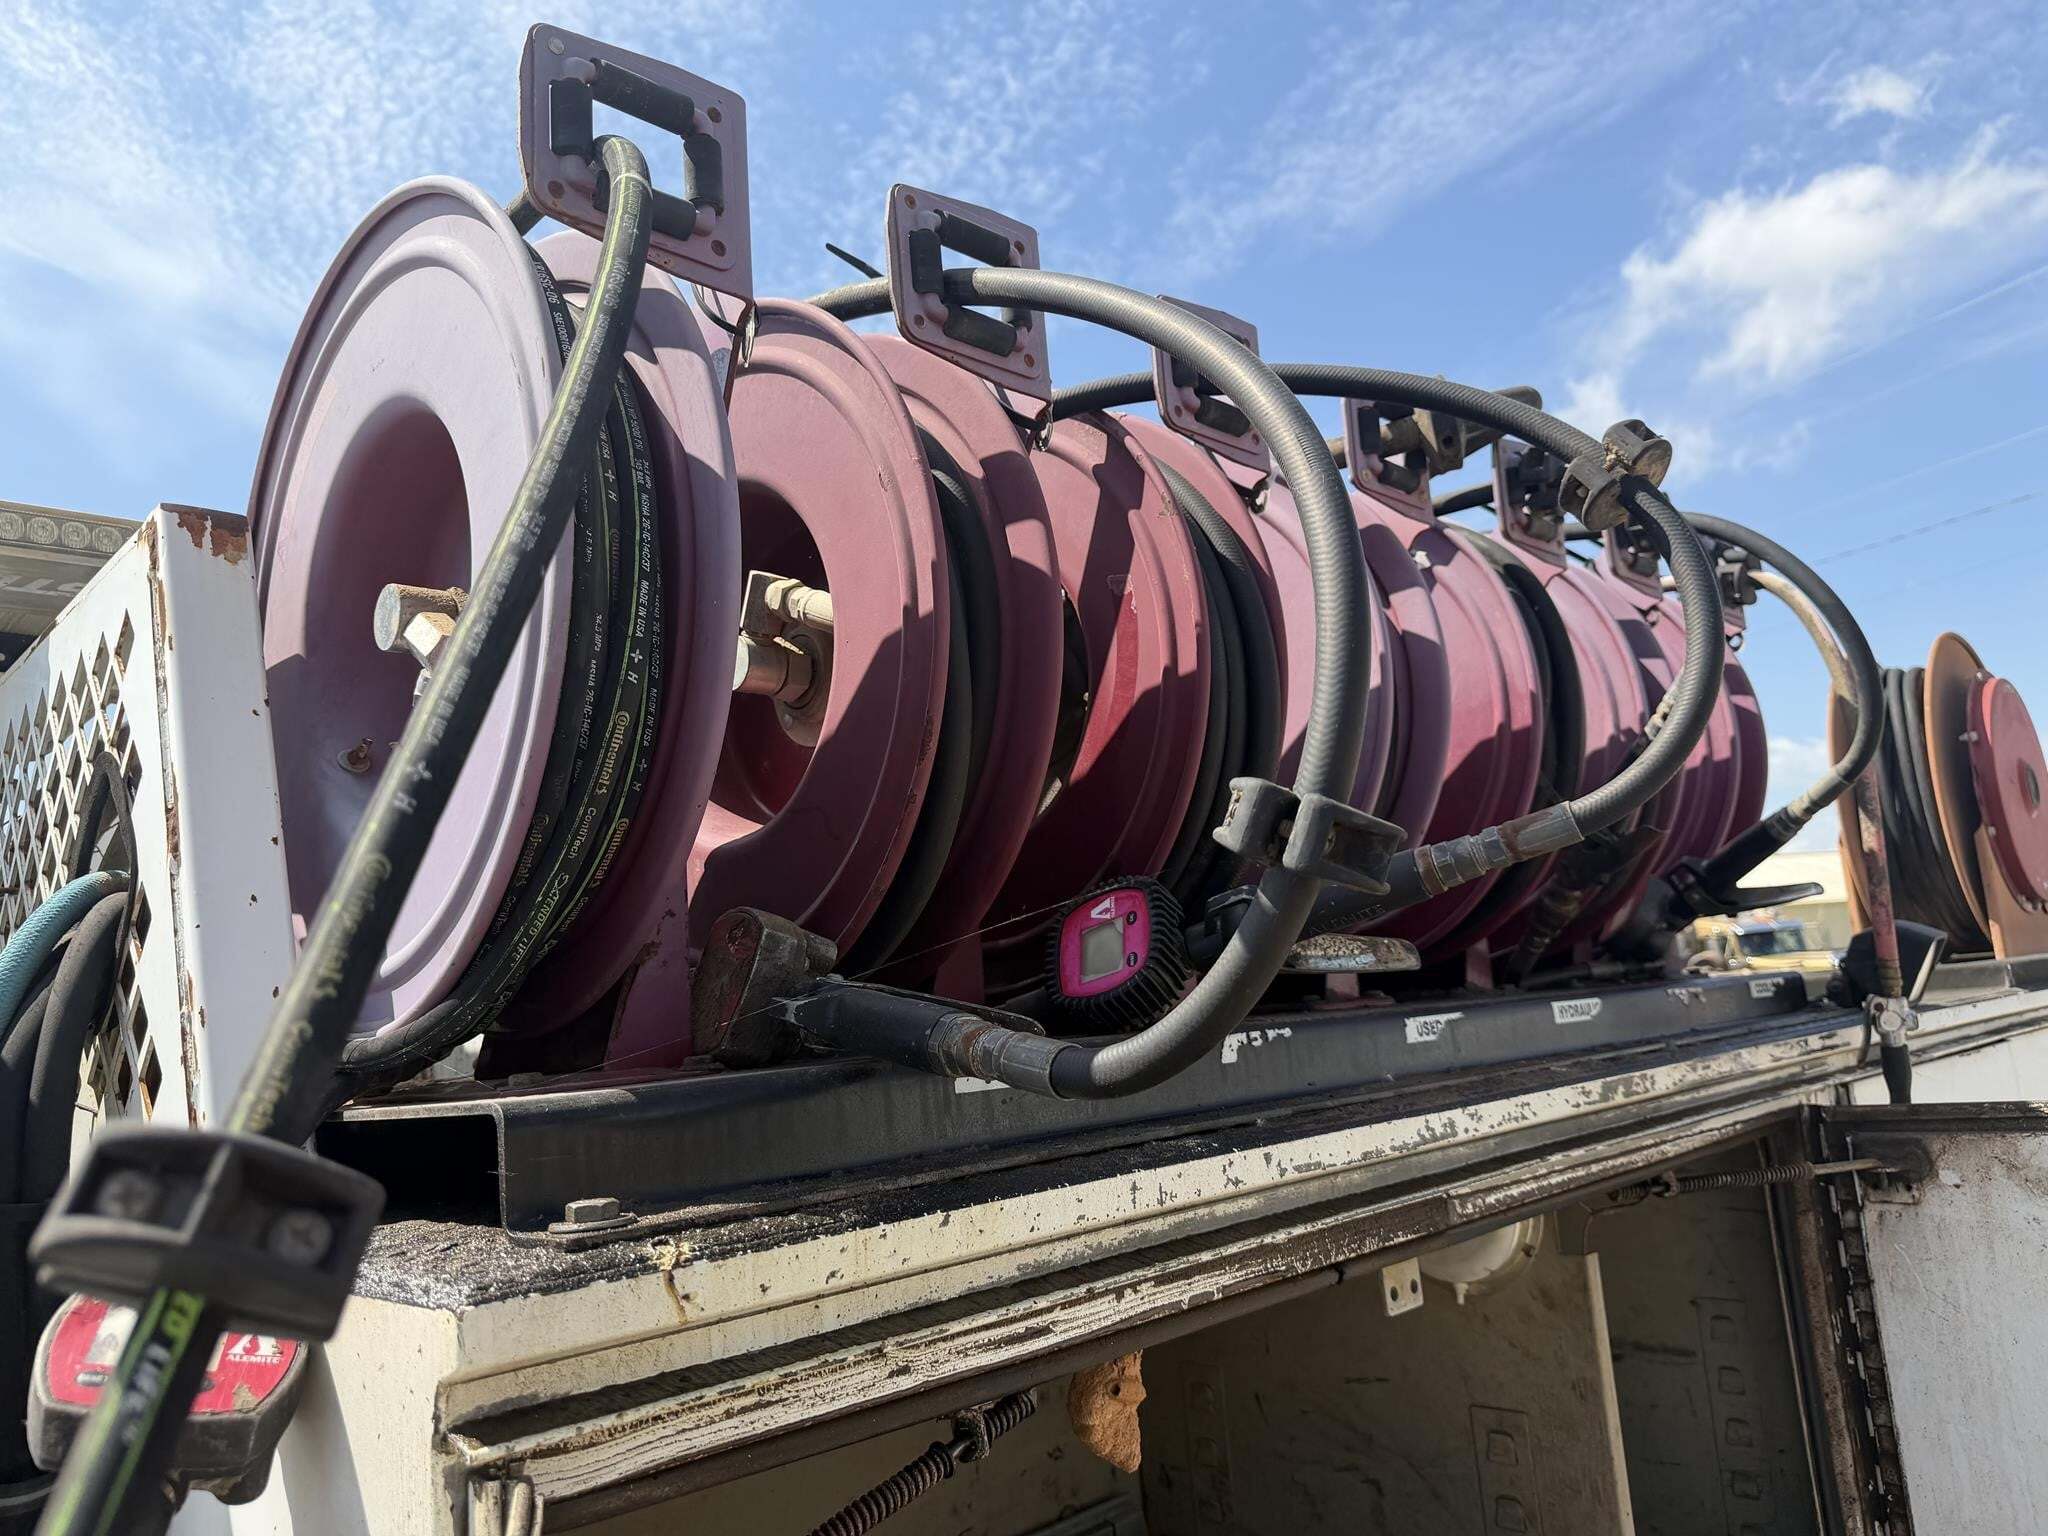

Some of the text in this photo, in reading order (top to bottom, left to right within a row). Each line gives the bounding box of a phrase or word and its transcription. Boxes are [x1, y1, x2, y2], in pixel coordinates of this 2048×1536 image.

[608, 489, 618, 502] H
[640, 493, 650, 516] MSHA
[639, 579, 649, 606] MADE
[638, 606, 647, 618] IN
[635, 618, 646, 638] USA
[627, 670, 639, 684] H
[598, 710, 630, 785] Continental
[567, 807, 597, 859] ContiTech
[225, 1353, 282, 1366] ALEMITE
